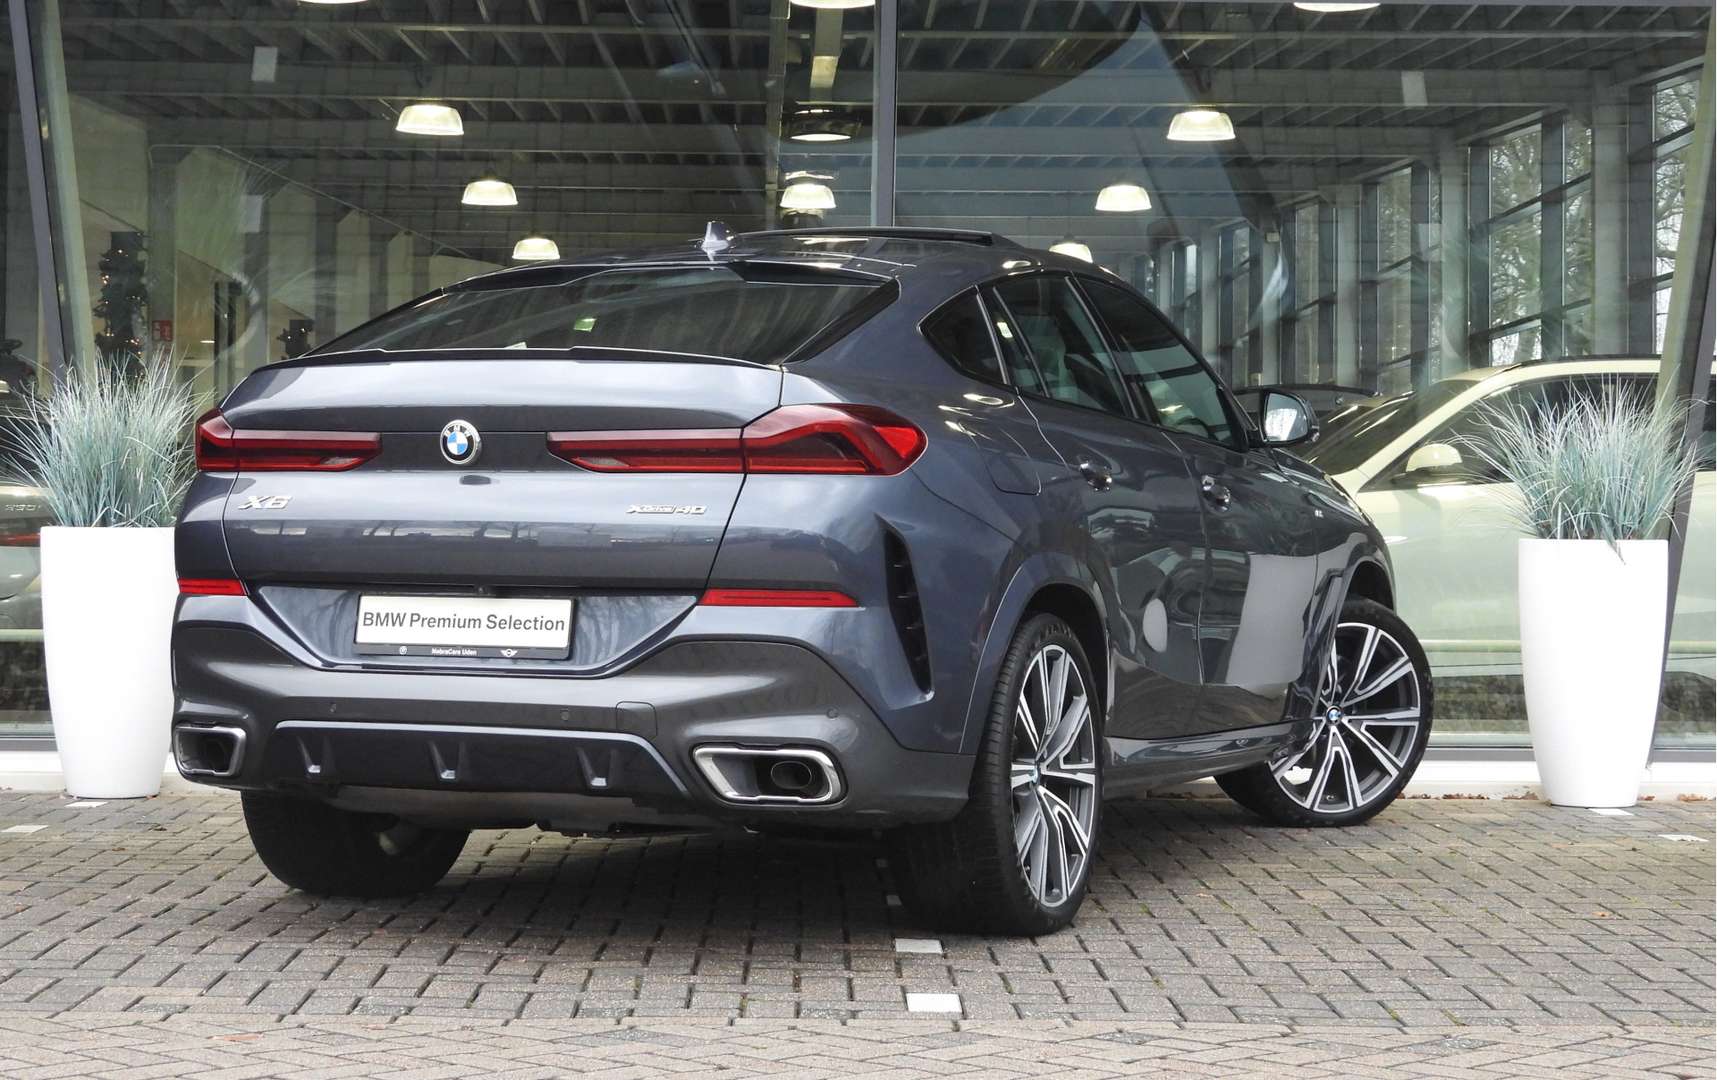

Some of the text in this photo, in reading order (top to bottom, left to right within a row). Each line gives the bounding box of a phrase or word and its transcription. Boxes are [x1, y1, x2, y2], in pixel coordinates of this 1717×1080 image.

[238, 495, 291, 510] X6
[363, 612, 565, 631] BMW Premium Selection
